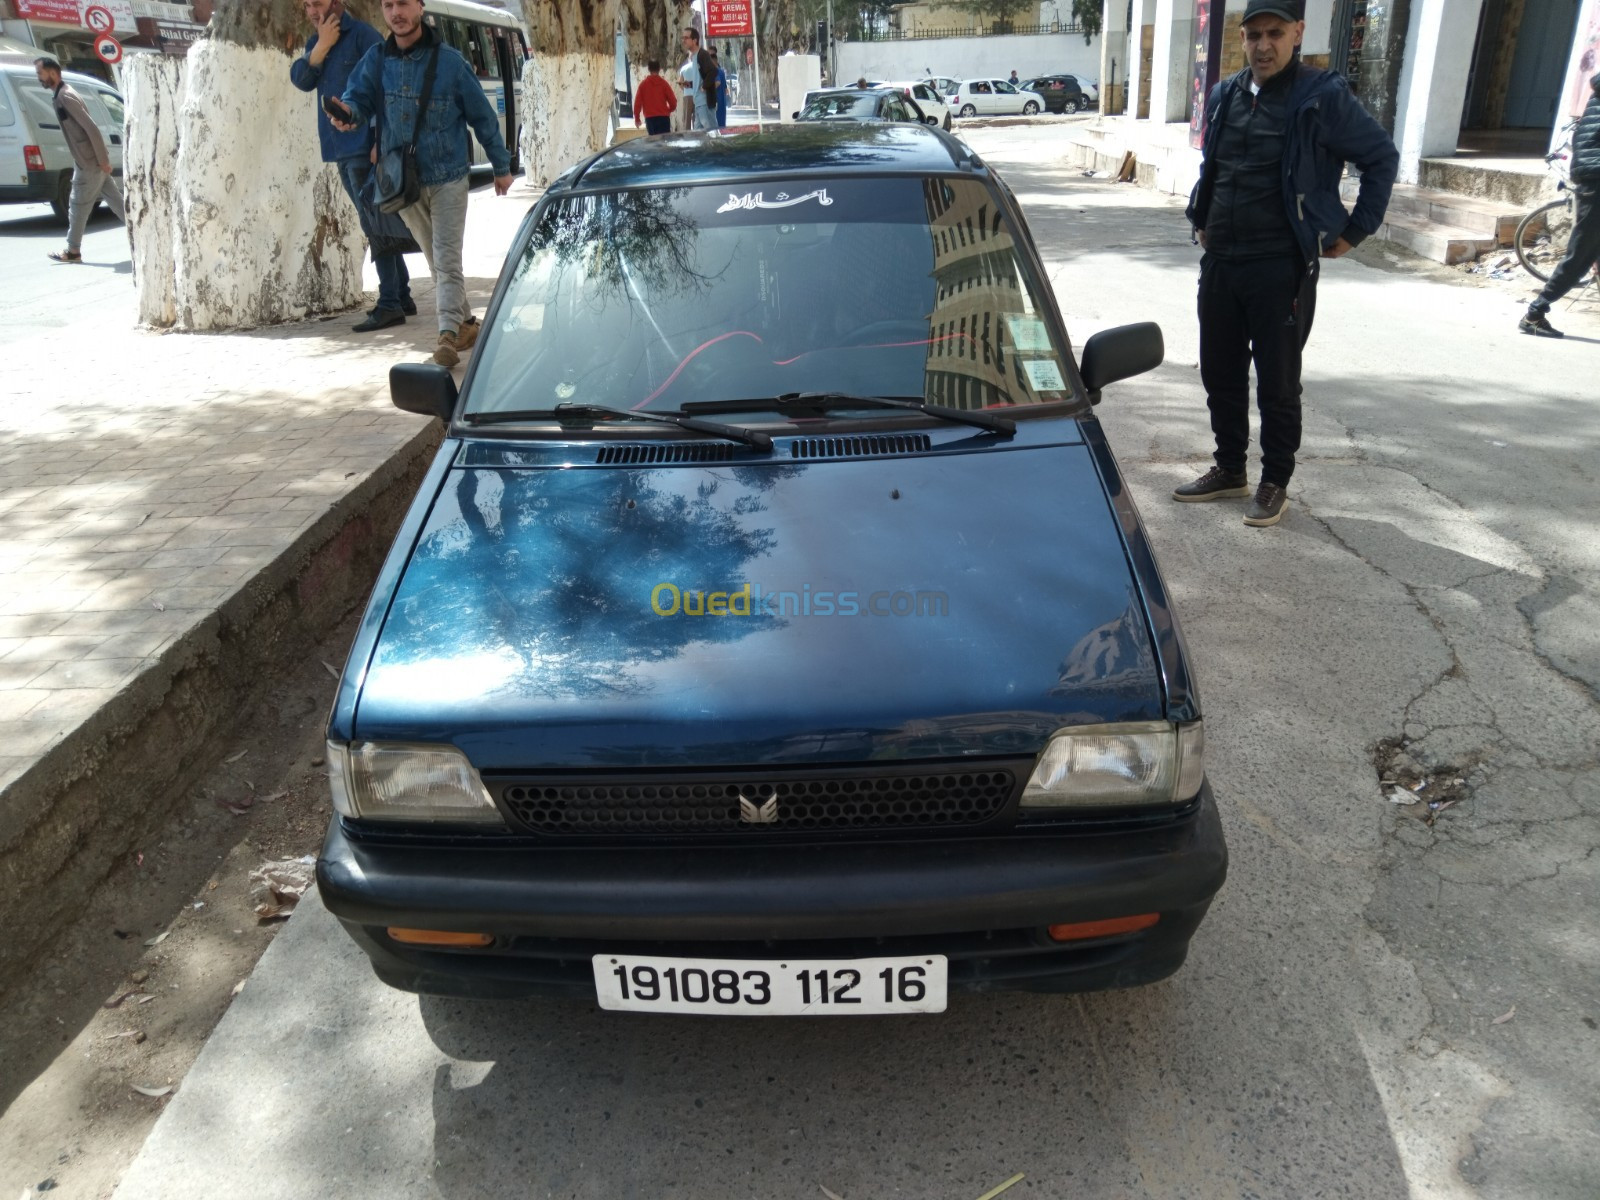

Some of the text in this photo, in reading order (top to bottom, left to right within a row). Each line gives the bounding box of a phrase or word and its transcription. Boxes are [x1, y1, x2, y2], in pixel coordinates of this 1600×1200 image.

[160, 29, 182, 40] Bilal
[613, 964, 926, 1005] 191083 112 16
